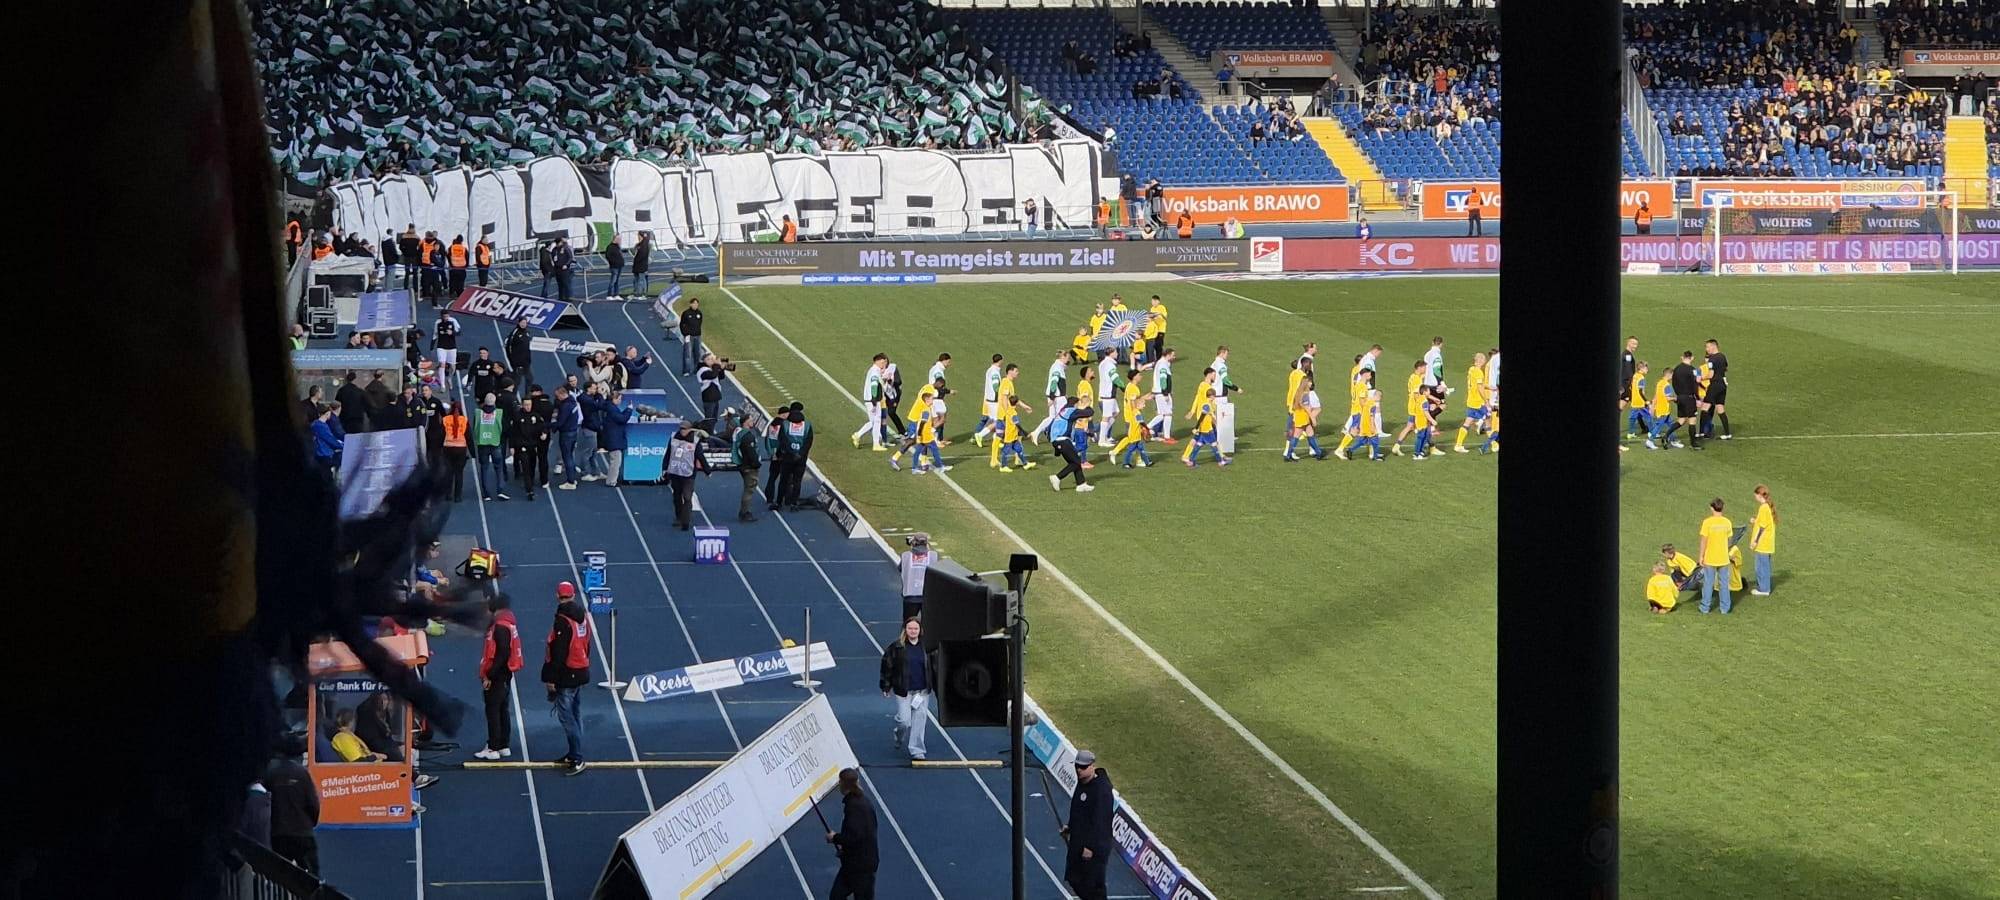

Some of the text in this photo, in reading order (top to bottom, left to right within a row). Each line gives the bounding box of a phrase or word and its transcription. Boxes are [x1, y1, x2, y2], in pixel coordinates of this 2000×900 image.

[1243, 54, 1323, 63] Volksbank BRAWO
[1932, 52, 1981, 61] Volksbank
[1844, 183, 1893, 192] LESSING
[1163, 194, 1321, 213] Volksbank BRAWO
[1760, 217, 1812, 228] WOLTERS
[1867, 217, 1921, 228] WOLTERS
[733, 248, 818, 258] BRAUNSCHWEIGER
[859, 247, 1115, 271] Mit Teamgeist zum Ziel!
[1156, 245, 1239, 255] BRAUNSCHWEIGER
[1176, 253, 1218, 262] ZEITUNG
[1450, 243, 1480, 263] WE
[1723, 241, 1746, 260] TO
[1752, 240, 1817, 260] WHERE
[1823, 240, 1840, 260] IT
[1845, 240, 1862, 260] IS
[1869, 240, 1942, 259] NEEDED
[755, 257, 797, 265] ZEITUNG
[461, 289, 555, 326] KOSATEC
[738, 655, 787, 677] Reese
[337, 681, 360, 691] Bank
[362, 680, 377, 691] für
[640, 673, 691, 695] Reese
[757, 712, 822, 776] BRAUNSCHWEIGER
[785, 747, 819, 789] ZEITUNG
[321, 773, 381, 788] #MeinKonto
[322, 780, 400, 798] bleibt kostenlos!
[652, 781, 735, 855] BRAUNSCHWEIGER
[685, 821, 729, 867] ZEITUNG
[1138, 846, 1177, 893] KOSATEC
